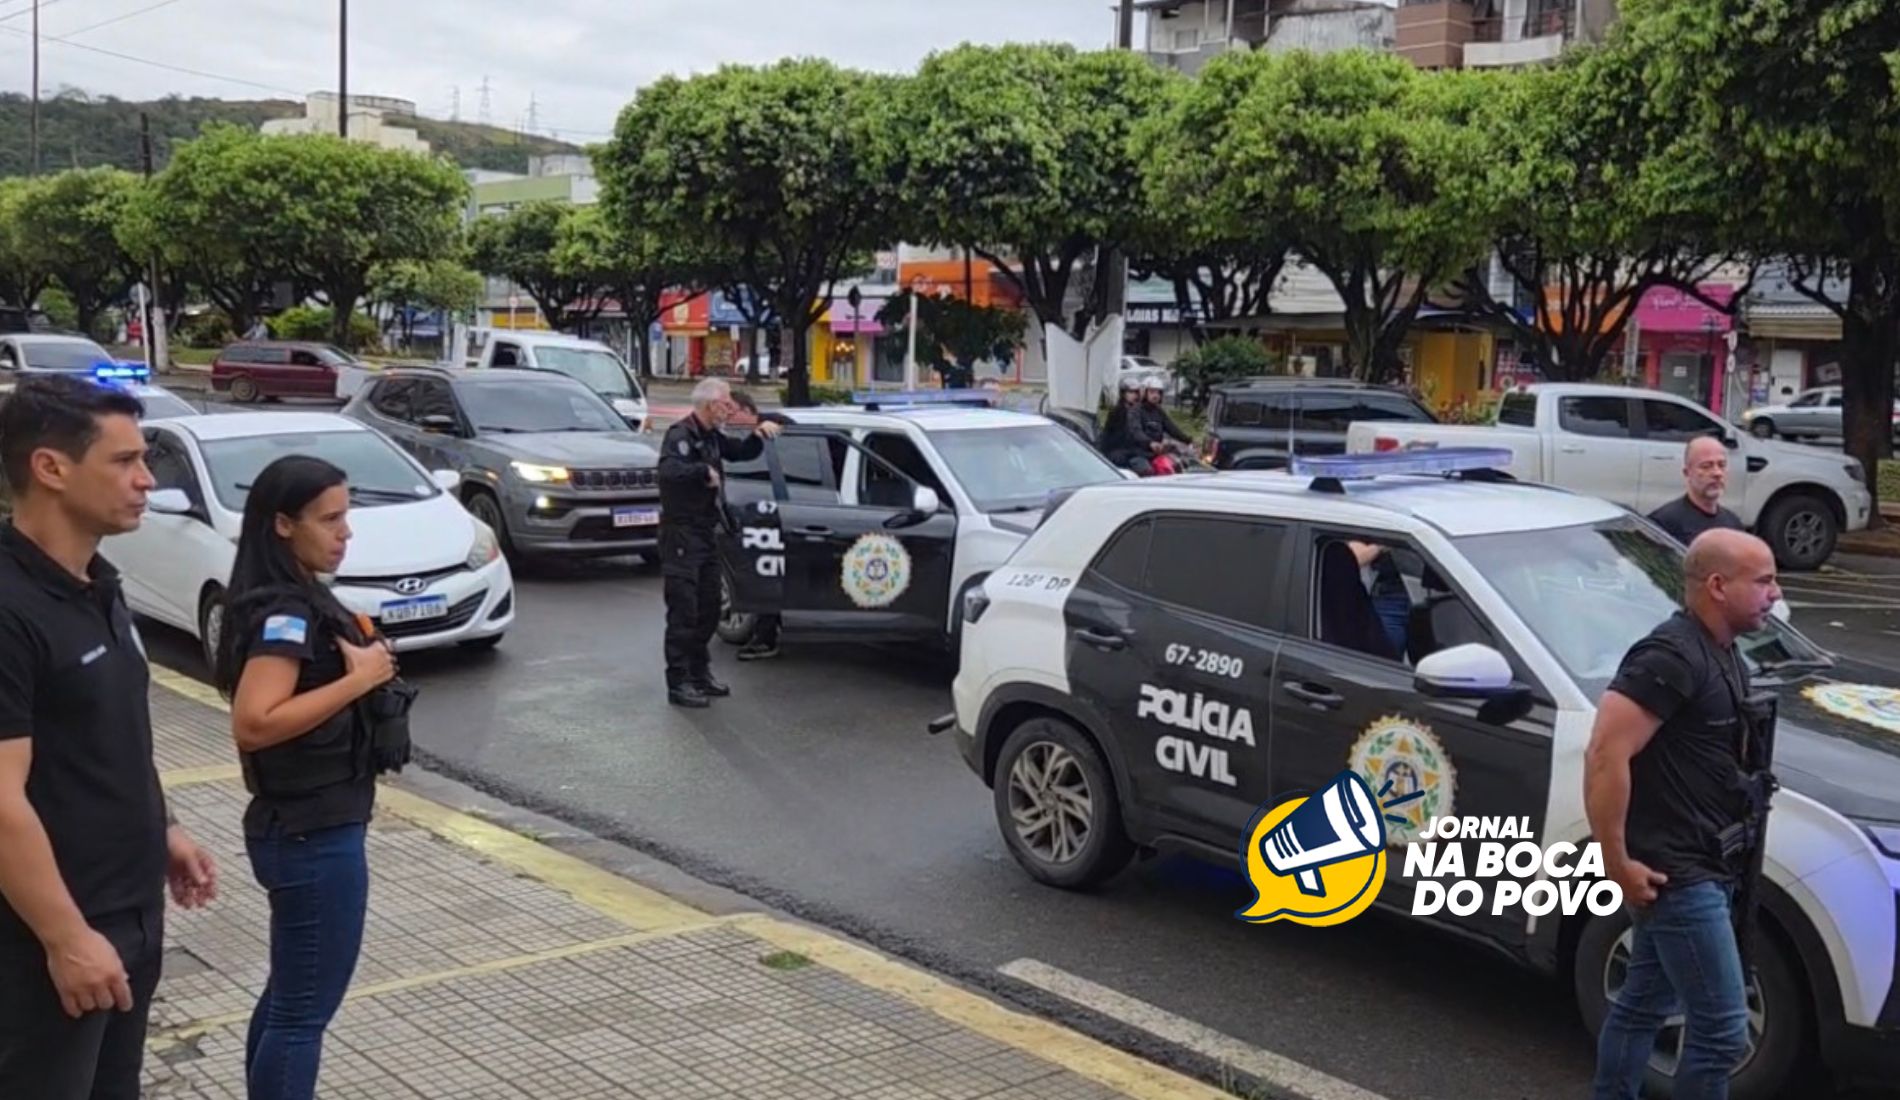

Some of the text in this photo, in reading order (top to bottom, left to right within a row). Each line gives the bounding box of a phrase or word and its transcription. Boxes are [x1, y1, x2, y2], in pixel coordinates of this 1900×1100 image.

[758, 501, 777, 514] 67
[1045, 576, 1071, 591] DP
[1165, 643, 1243, 678] 67-2890
[1137, 683, 1256, 748] POLÍCIA
[1155, 735, 1238, 786] CIVIL
